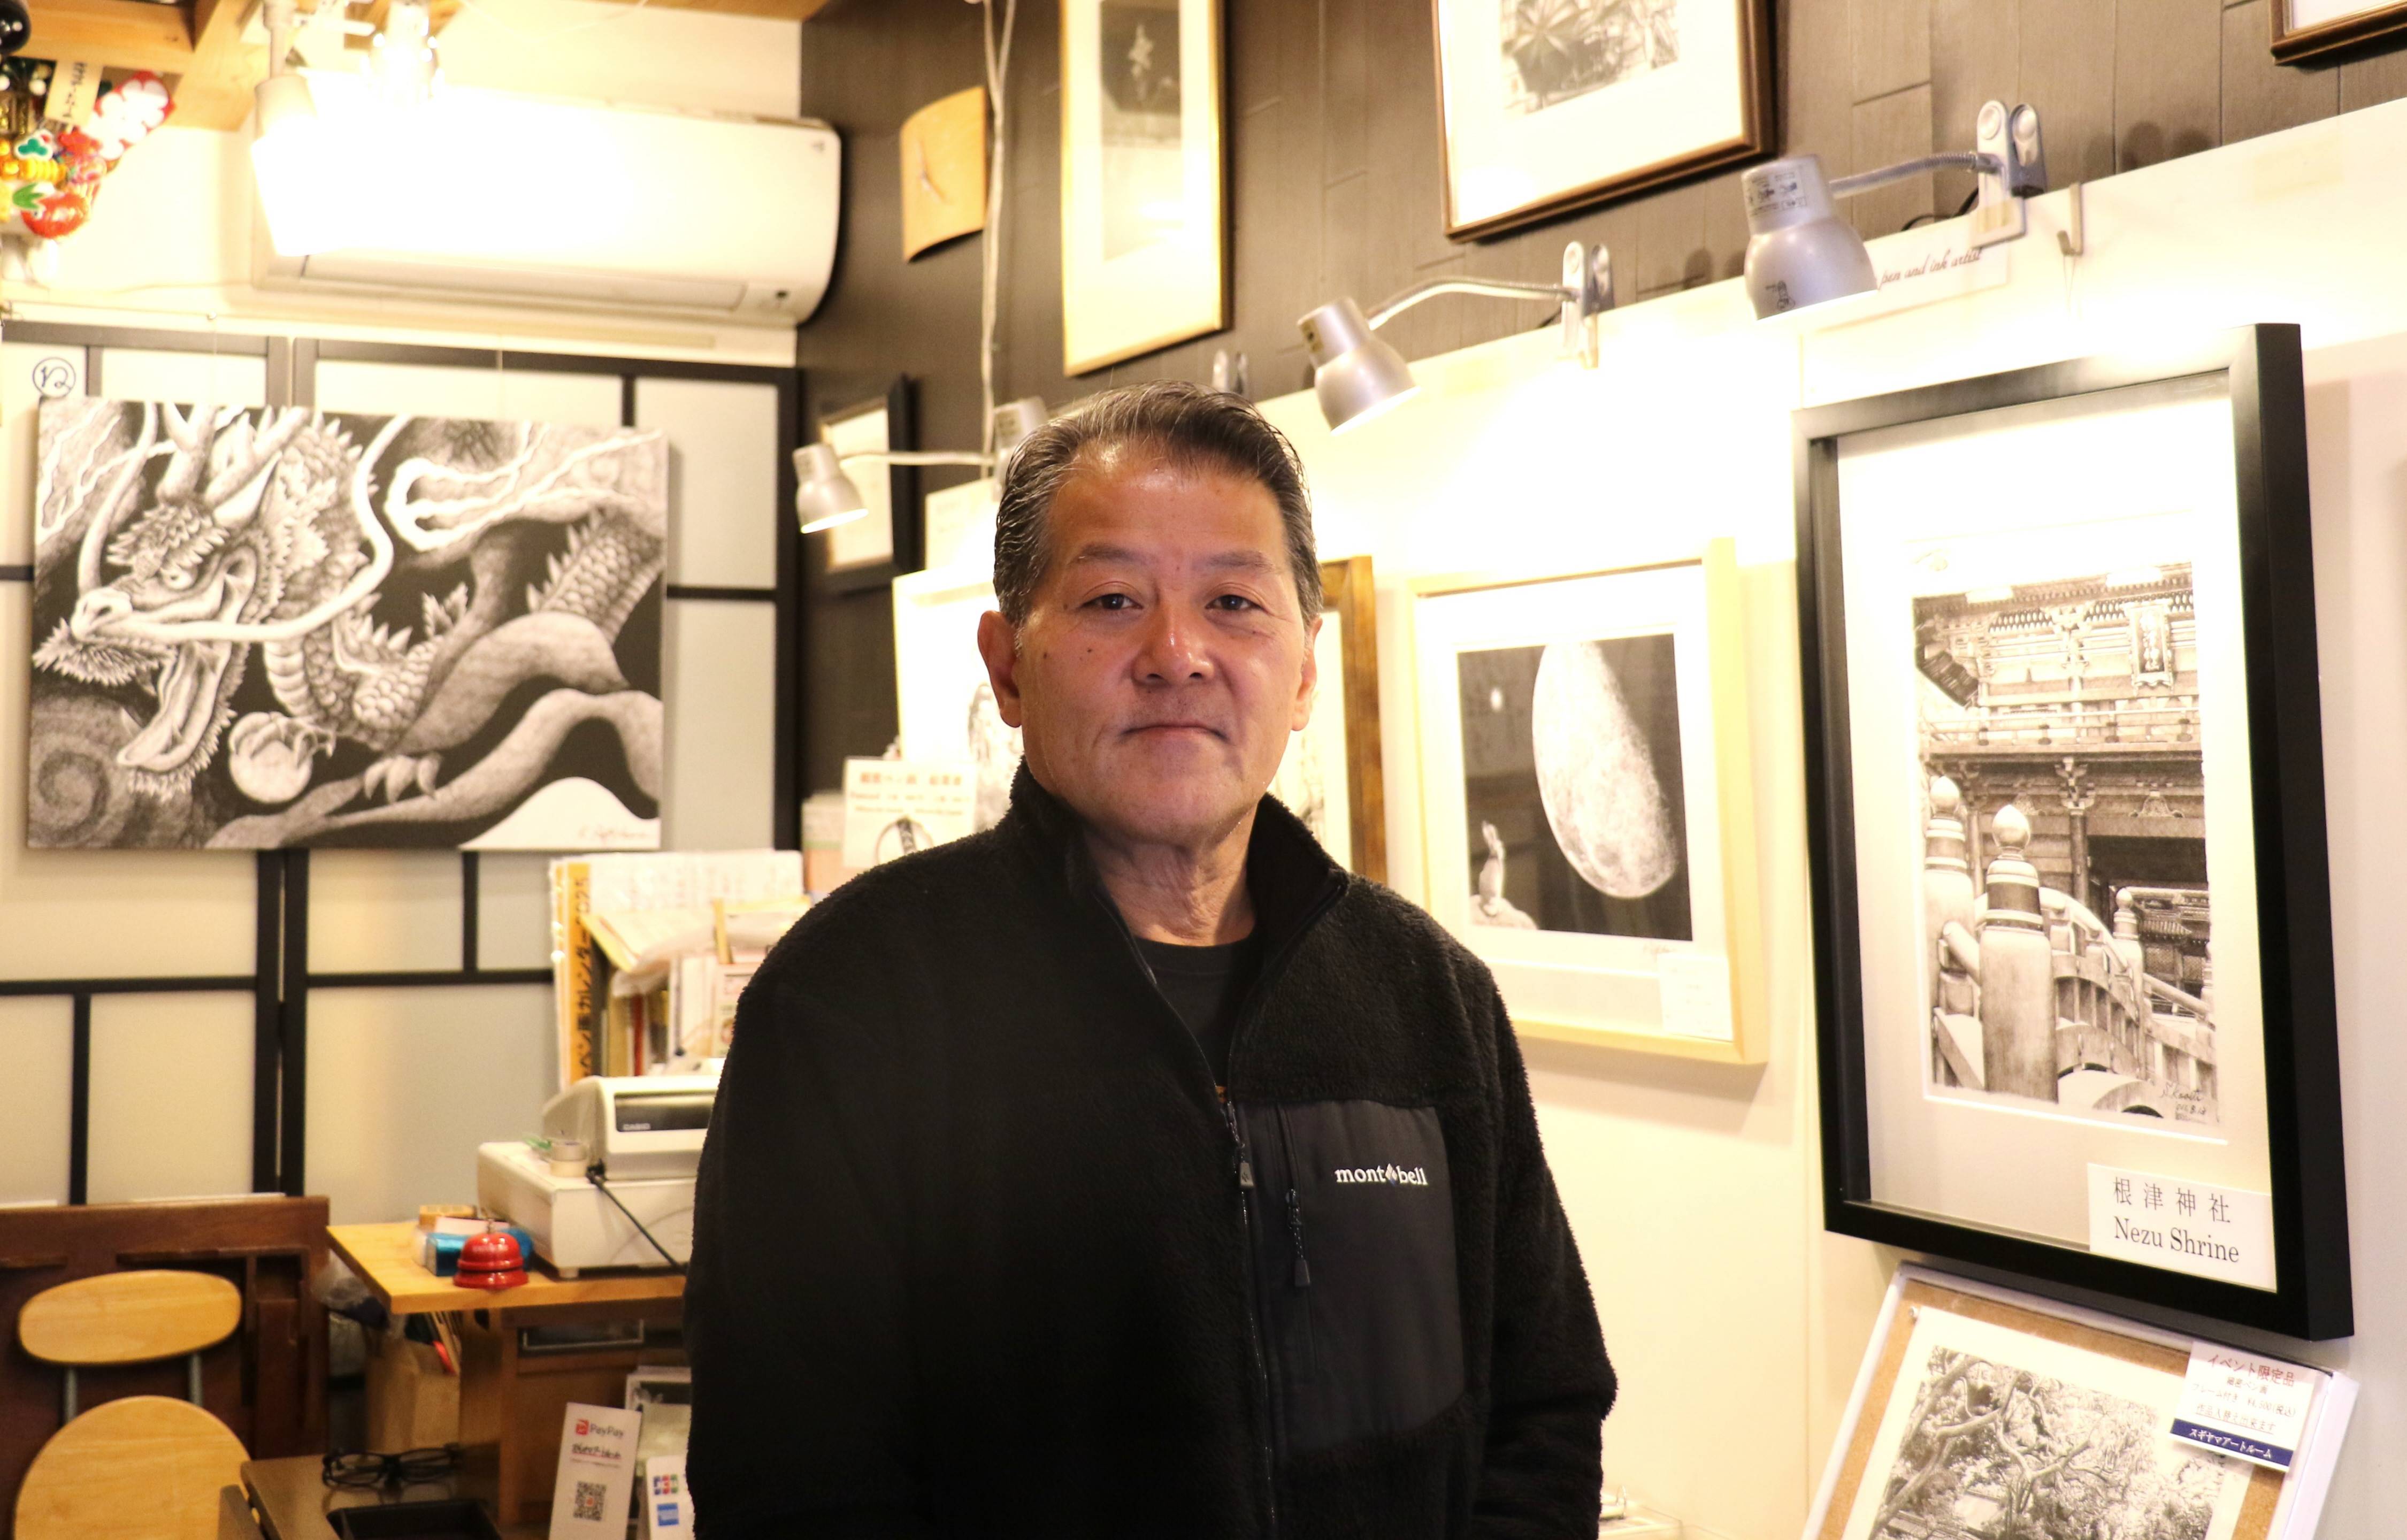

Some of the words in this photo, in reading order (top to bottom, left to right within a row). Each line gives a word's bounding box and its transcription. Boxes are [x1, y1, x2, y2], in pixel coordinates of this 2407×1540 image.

[1879, 270, 1900, 290] pen
[1904, 254, 1931, 278] and
[1929, 248, 1951, 272] ink
[2113, 1176, 2230, 1223] 根津神社
[2114, 1216, 2163, 1247] Nezu
[2170, 1227, 2239, 1263] Shrine
[2207, 1354, 2294, 1386] イベント限定品
[590, 1423, 623, 1438] PayPay
[2189, 1428, 2273, 1459] スギヤマアートルーム
